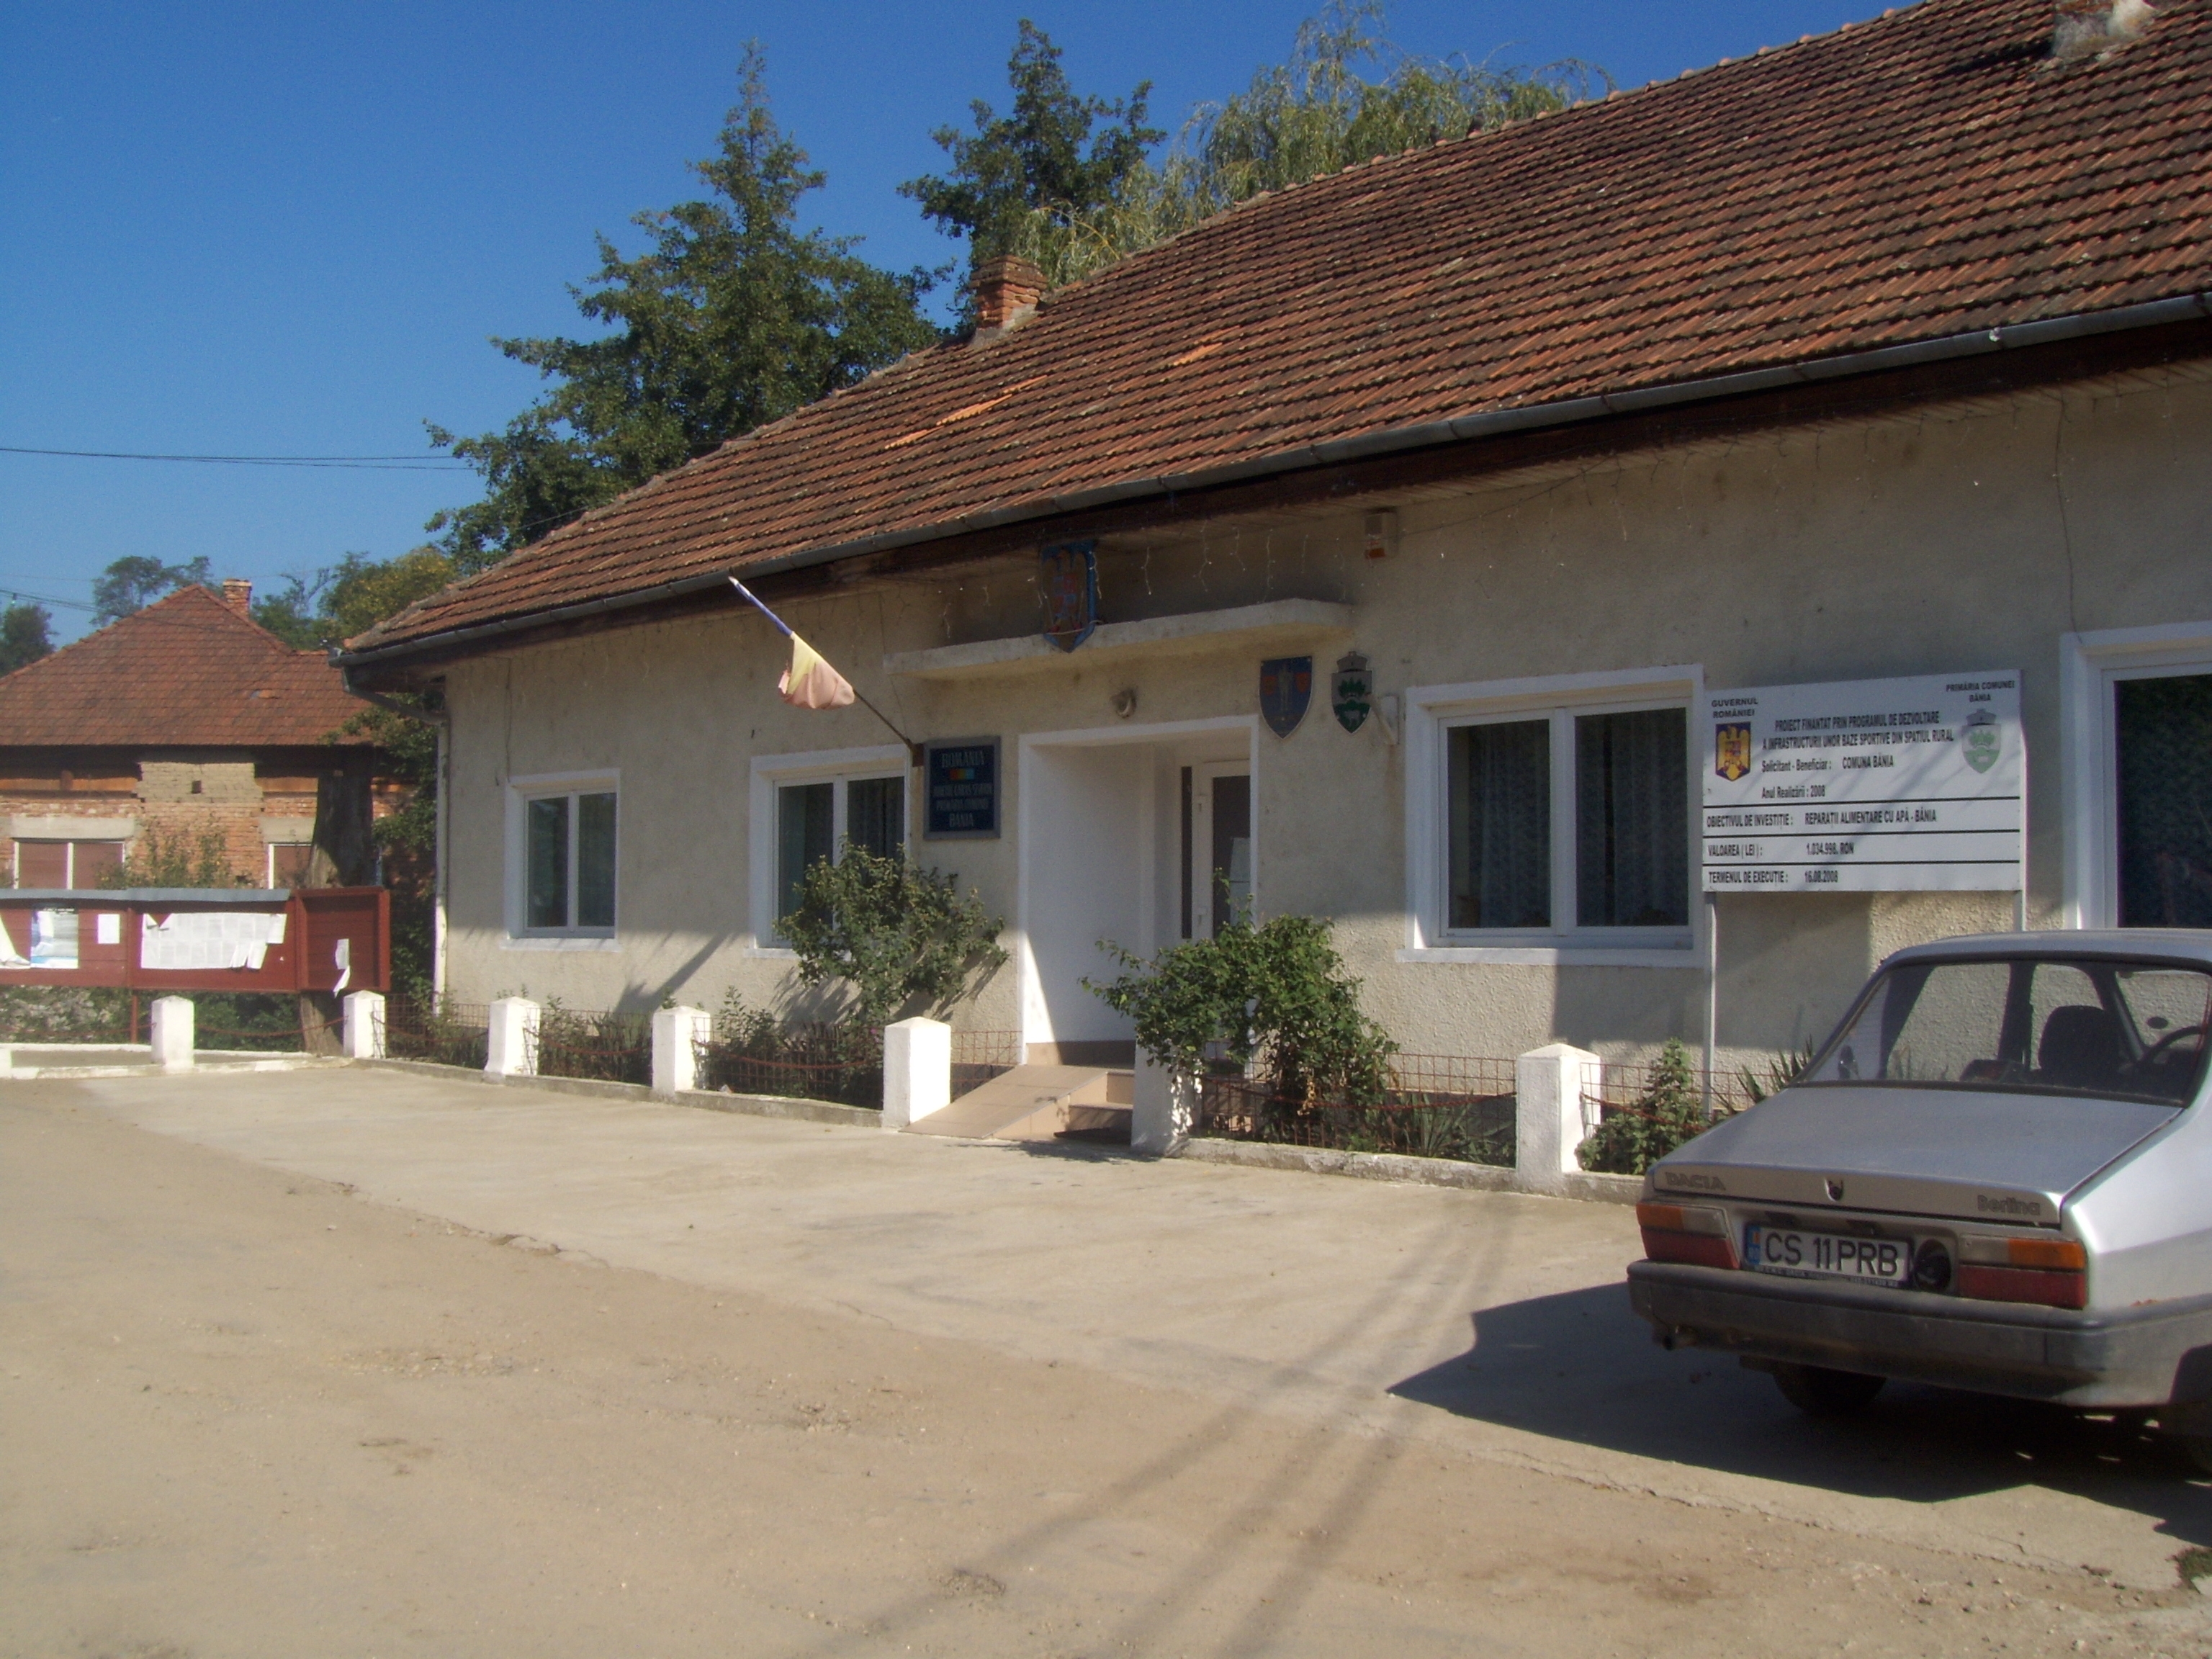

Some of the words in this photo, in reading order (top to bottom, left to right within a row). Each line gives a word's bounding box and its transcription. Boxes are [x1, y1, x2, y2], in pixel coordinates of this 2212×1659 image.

[1982, 680, 2015, 689] COMUNEI
[1712, 697, 1758, 708] GUVERNUL
[1775, 719, 1801, 732] PROIECT
[1832, 716, 1847, 729] PRIN
[1848, 714, 1887, 728] PROGRAMUL
[1889, 713, 1897, 726] DE
[1898, 710, 1939, 726] DEZVOLTARE
[1762, 737, 1768, 750] A
[1822, 734, 1840, 747] UNOR
[1842, 733, 1858, 746] BAZE
[1859, 732, 1890, 745] SPORTIVE
[1892, 731, 1903, 744] DIN
[1932, 729, 1954, 742] RURAL
[1761, 760, 1791, 773] Solicitant
[1843, 756, 1871, 769] COMUNA
[1761, 786, 1775, 799] Anul
[1810, 785, 1825, 797] 2008
[1707, 814, 1743, 827] OBIECTIVUL
[1745, 814, 1753, 827] DE
[1840, 811, 1882, 824] ALIMENTARE
[1884, 810, 1894, 823] CU
[1708, 844, 1740, 857] VALOAREA
[1840, 842, 1854, 855] RON
[1709, 871, 1742, 884] TERMENUL
[1743, 871, 1751, 883] DE
[1665, 1172, 1726, 1191] DACIA
[1977, 1195, 2041, 1215] Berlina
[1766, 1231, 1802, 1266] CS
